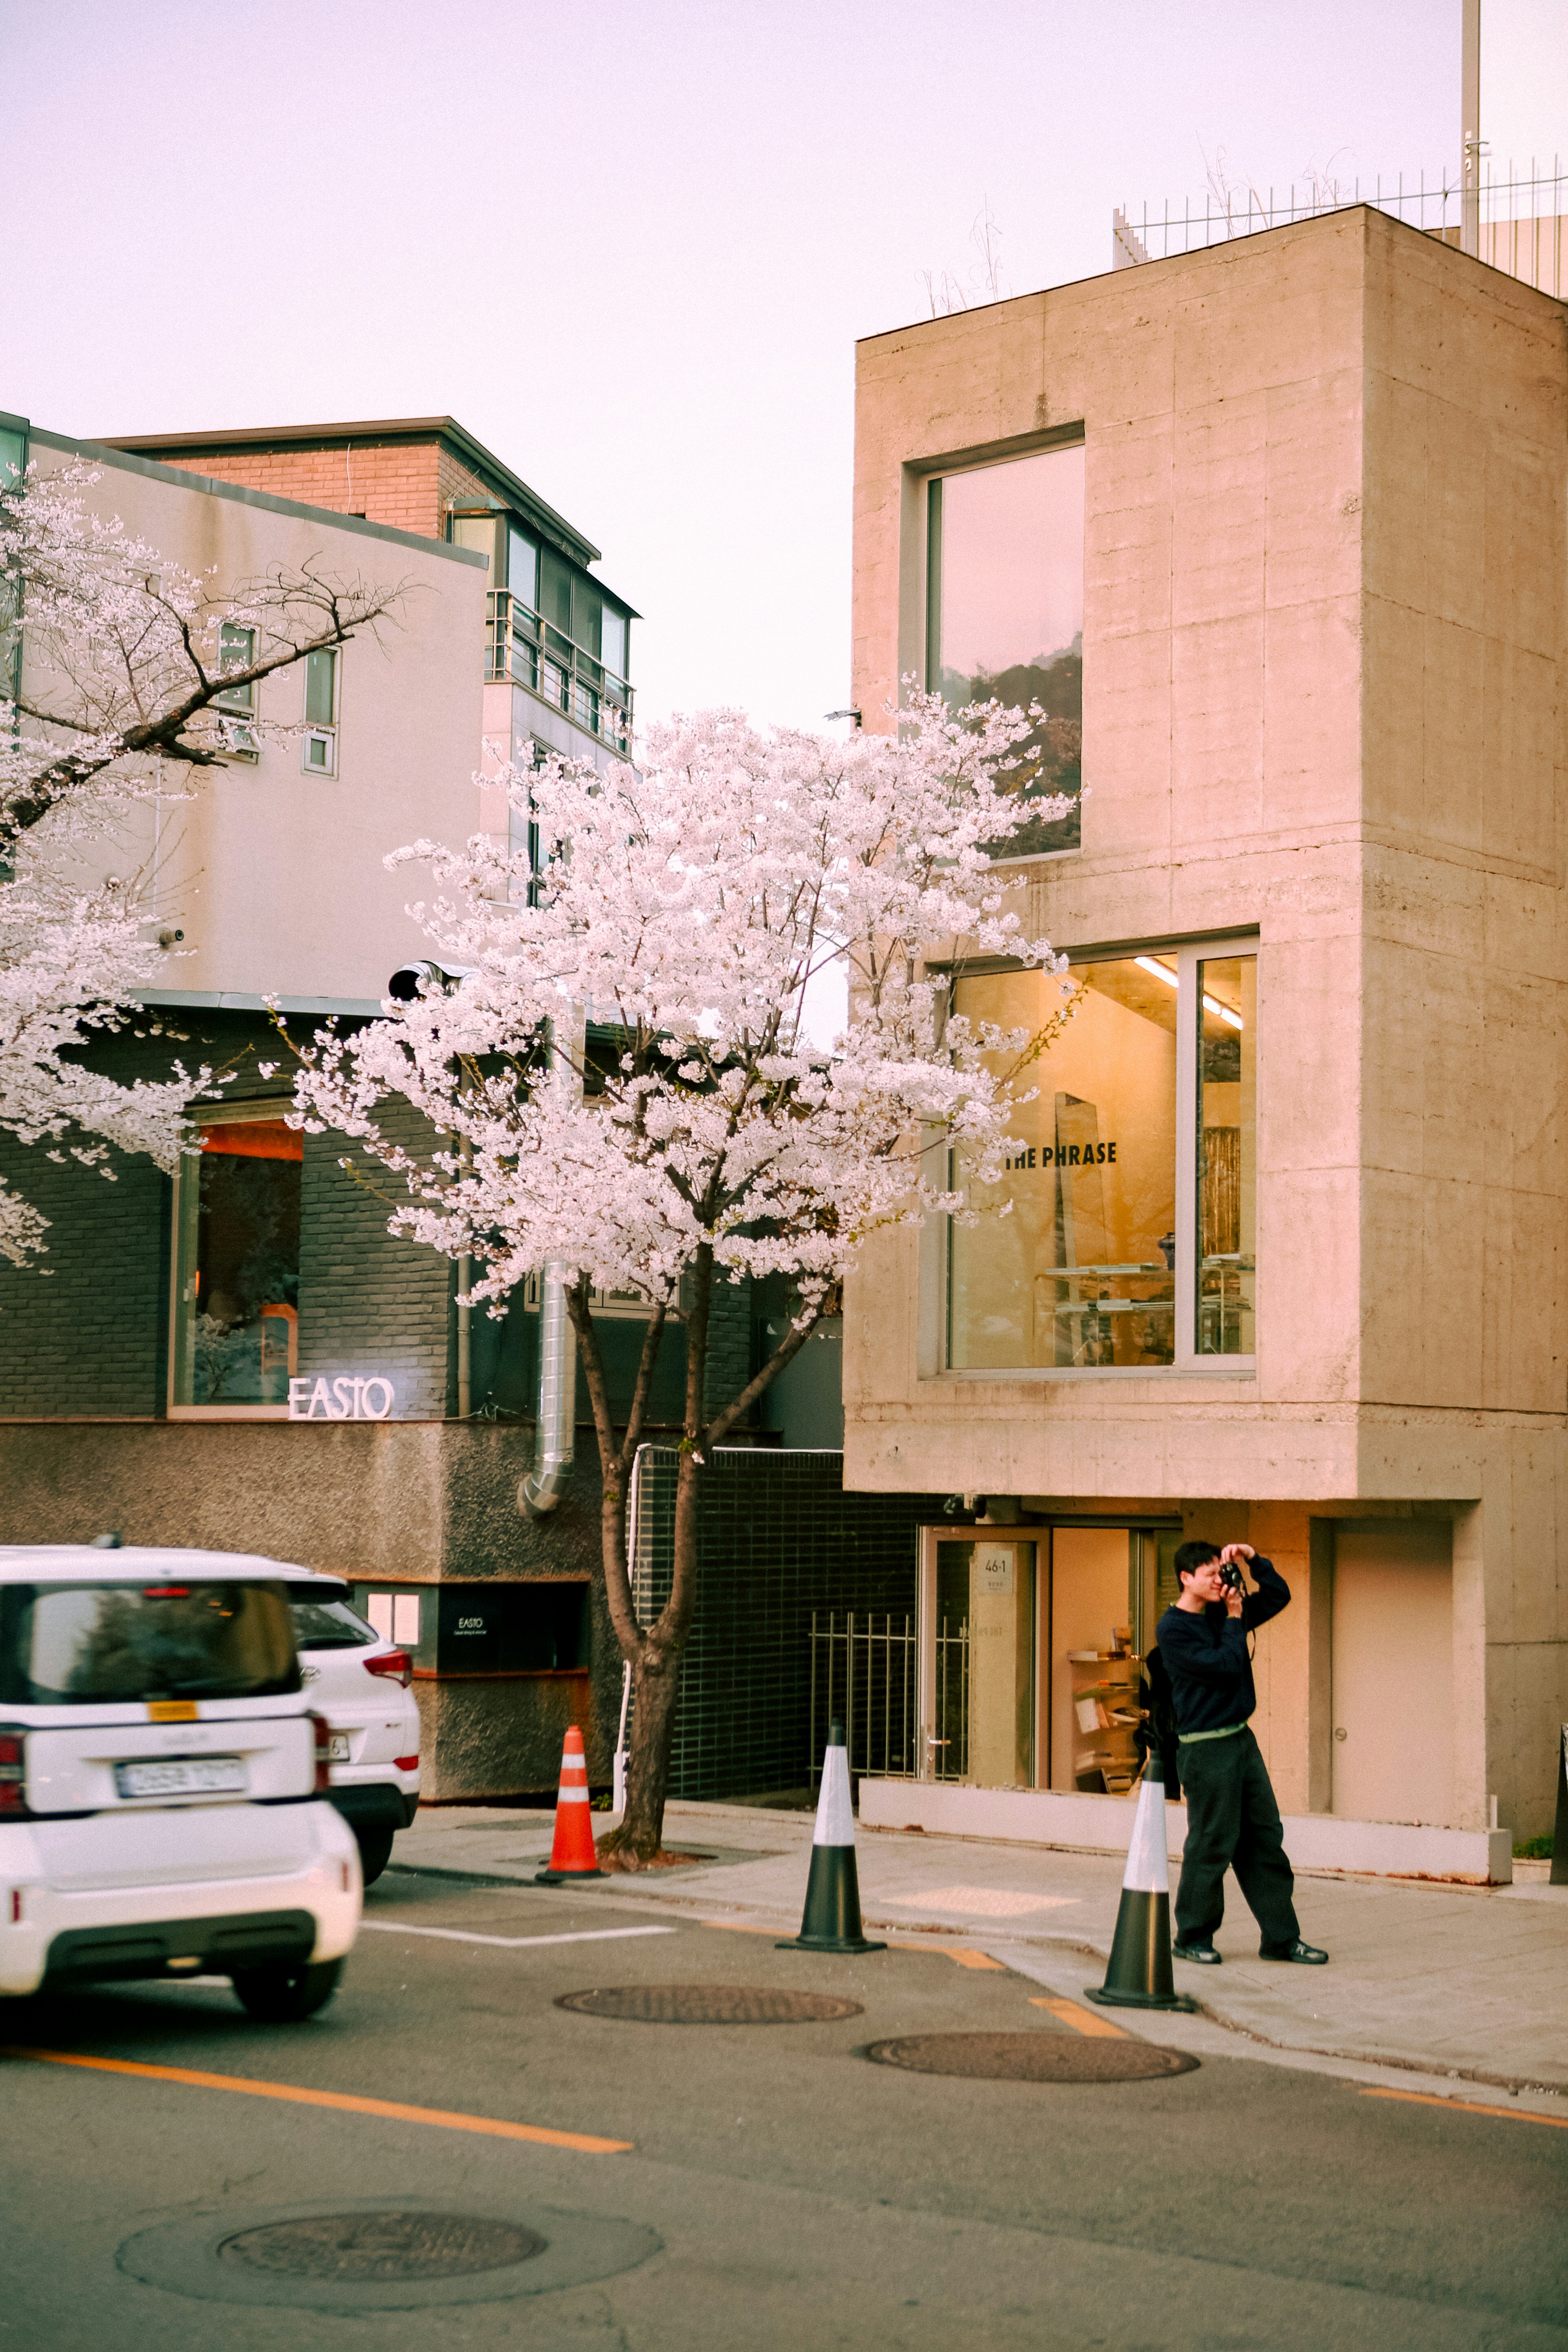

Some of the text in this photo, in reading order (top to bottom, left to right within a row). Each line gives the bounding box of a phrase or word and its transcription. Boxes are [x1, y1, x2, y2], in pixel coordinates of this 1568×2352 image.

[1042, 1142, 1116, 1167] PHRASE
[287, 1377, 394, 1419] EASTO
[459, 1617, 483, 1628] EASTO
